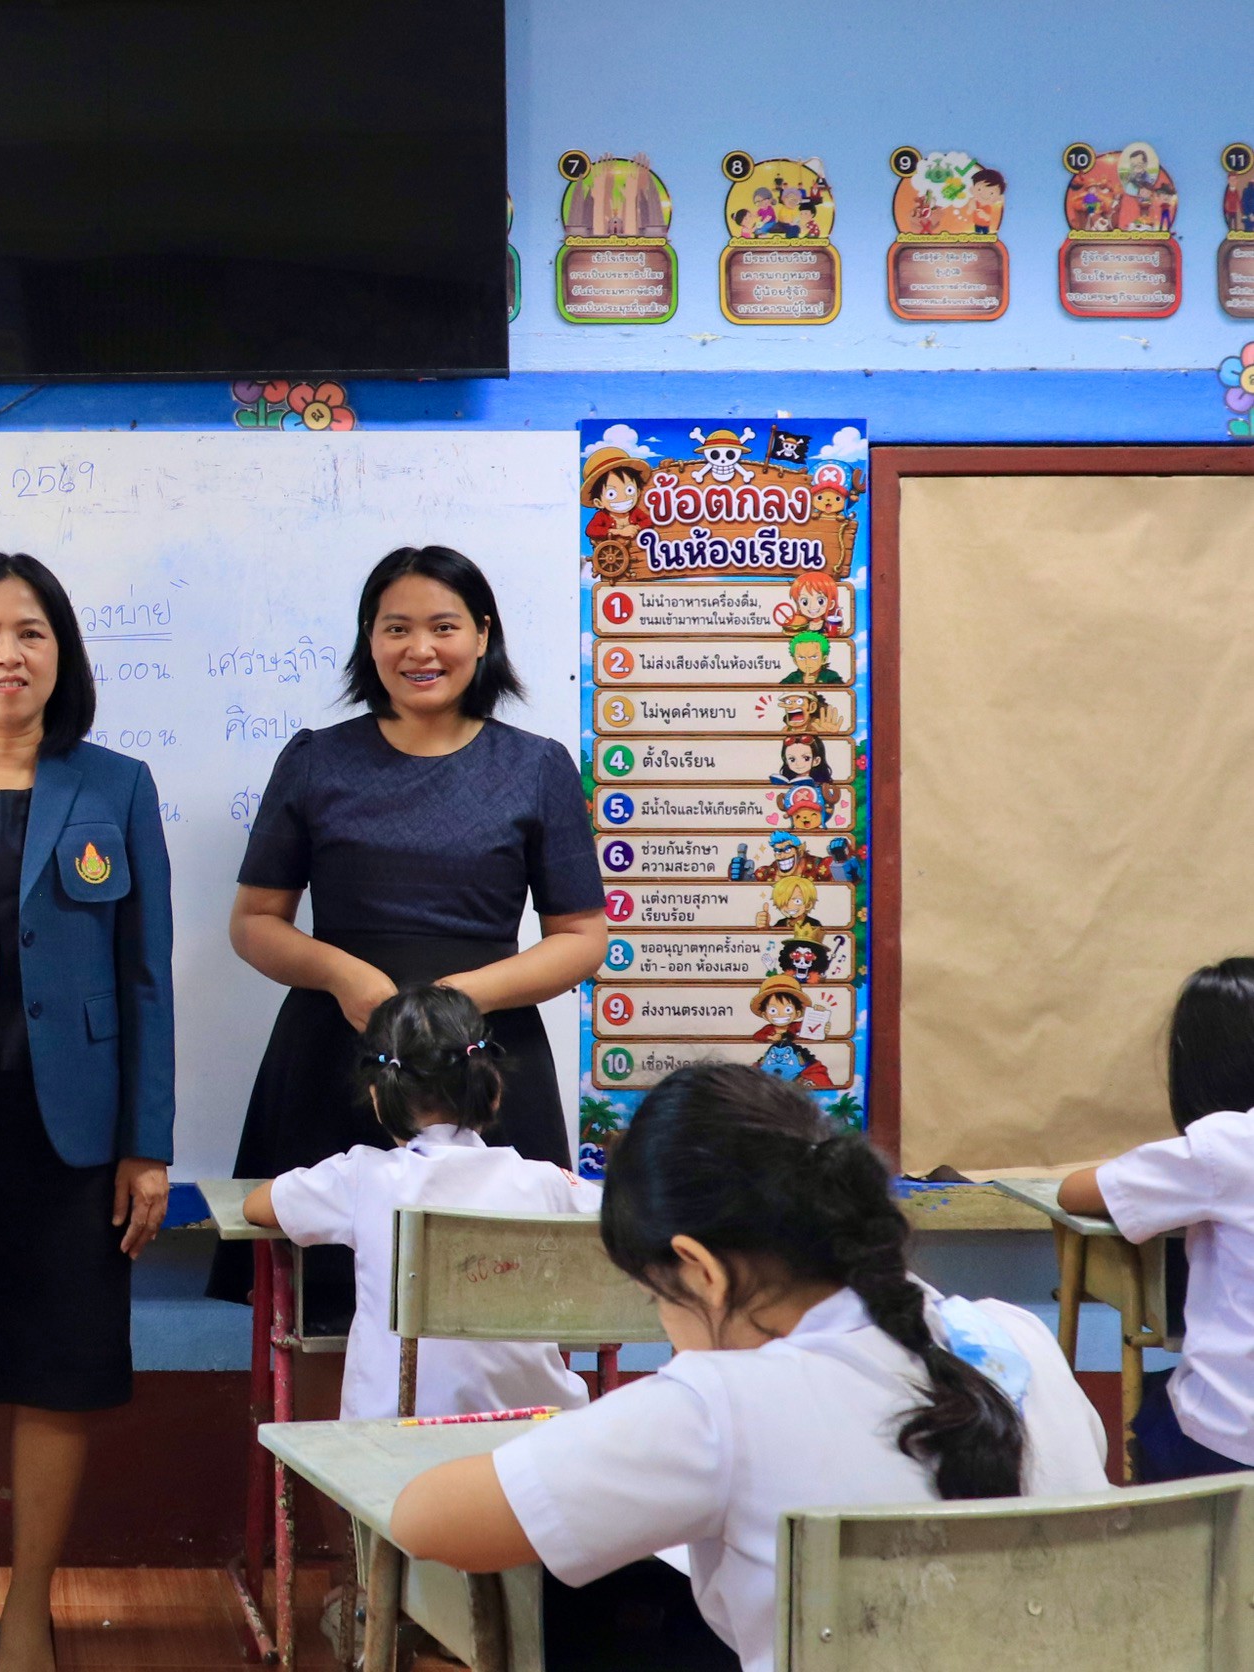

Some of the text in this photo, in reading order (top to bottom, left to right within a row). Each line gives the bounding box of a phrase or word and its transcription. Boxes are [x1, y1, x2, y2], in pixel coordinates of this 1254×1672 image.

[568, 160, 580, 174] 7
[732, 160, 743, 174] 8
[899, 155, 911, 171] 9
[1070, 153, 1088, 166] 10
[1229, 154, 1245, 166] 11
[11, 461, 95, 499] 2569
[647, 476, 811, 522] ข้อตกลง
[639, 529, 823, 569] ในห้องเรียน
[611, 590, 761, 618] 1. ไม่นำอาหารเครื่องดื่ม,
[639, 613, 771, 627] ขนมเข้ามาทานในห้องเรียน
[609, 652, 781, 673] 2. ไม่ส่งเสียงดังในห้องเรียน
[609, 701, 736, 723] 3. ไม่พูดคำหยาบ
[609, 745, 715, 771] 4. ตั้งใจเรียน
[609, 798, 763, 818] 5. มีน้ำใจและให้เกียรติกัน
[608, 840, 718, 866] 6. ช่วยกันรักษา
[641, 860, 715, 874] ความสะอาด
[609, 890, 728, 916] 7. แต่งกายสุภาพ
[641, 906, 695, 923] เรียบร้อย
[608, 940, 761, 965] 8. ขออนุญาตทุกครั้งก่อน
[696, 960, 749, 974] ห้องเสมอ
[609, 997, 734, 1018] 9. ส่งงานตรงเวลา
[605, 1053, 631, 1074] 10.
